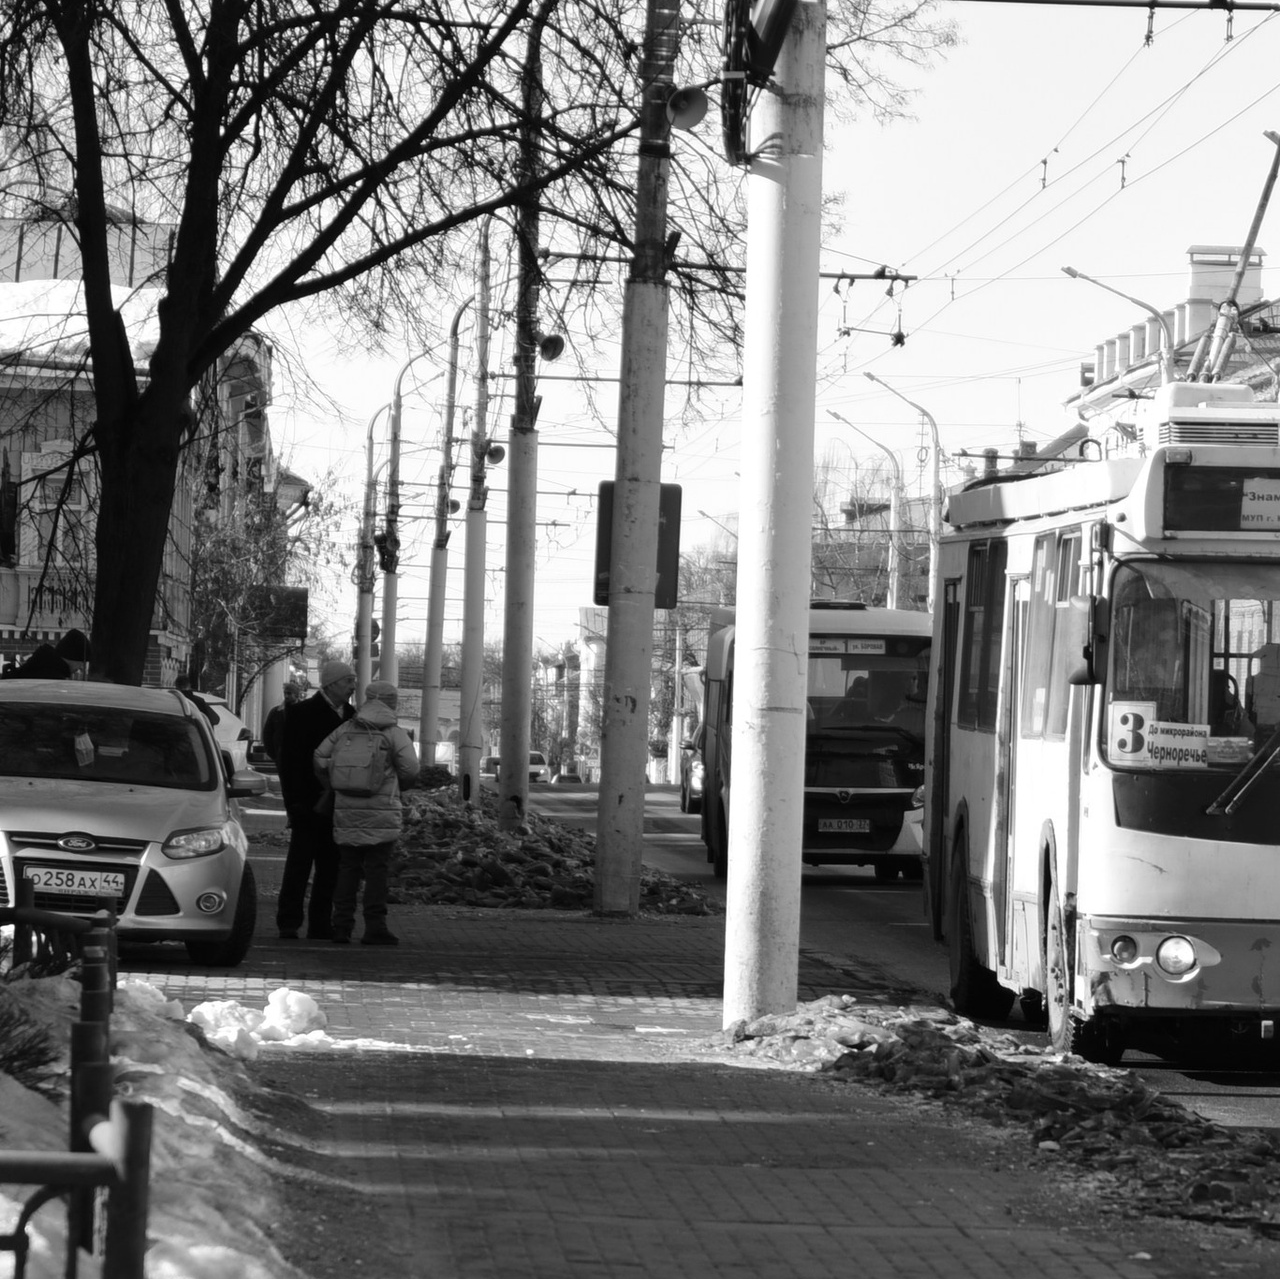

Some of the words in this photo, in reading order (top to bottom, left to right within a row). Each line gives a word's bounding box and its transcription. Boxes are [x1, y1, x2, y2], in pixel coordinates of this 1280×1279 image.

[1241, 514, 1263, 522] МУП
[1117, 712, 1145, 754] 3
[1149, 724, 1158, 735] До
[1160, 725, 1207, 739] микрорайона
[1147, 741, 1207, 766] Черноречье
